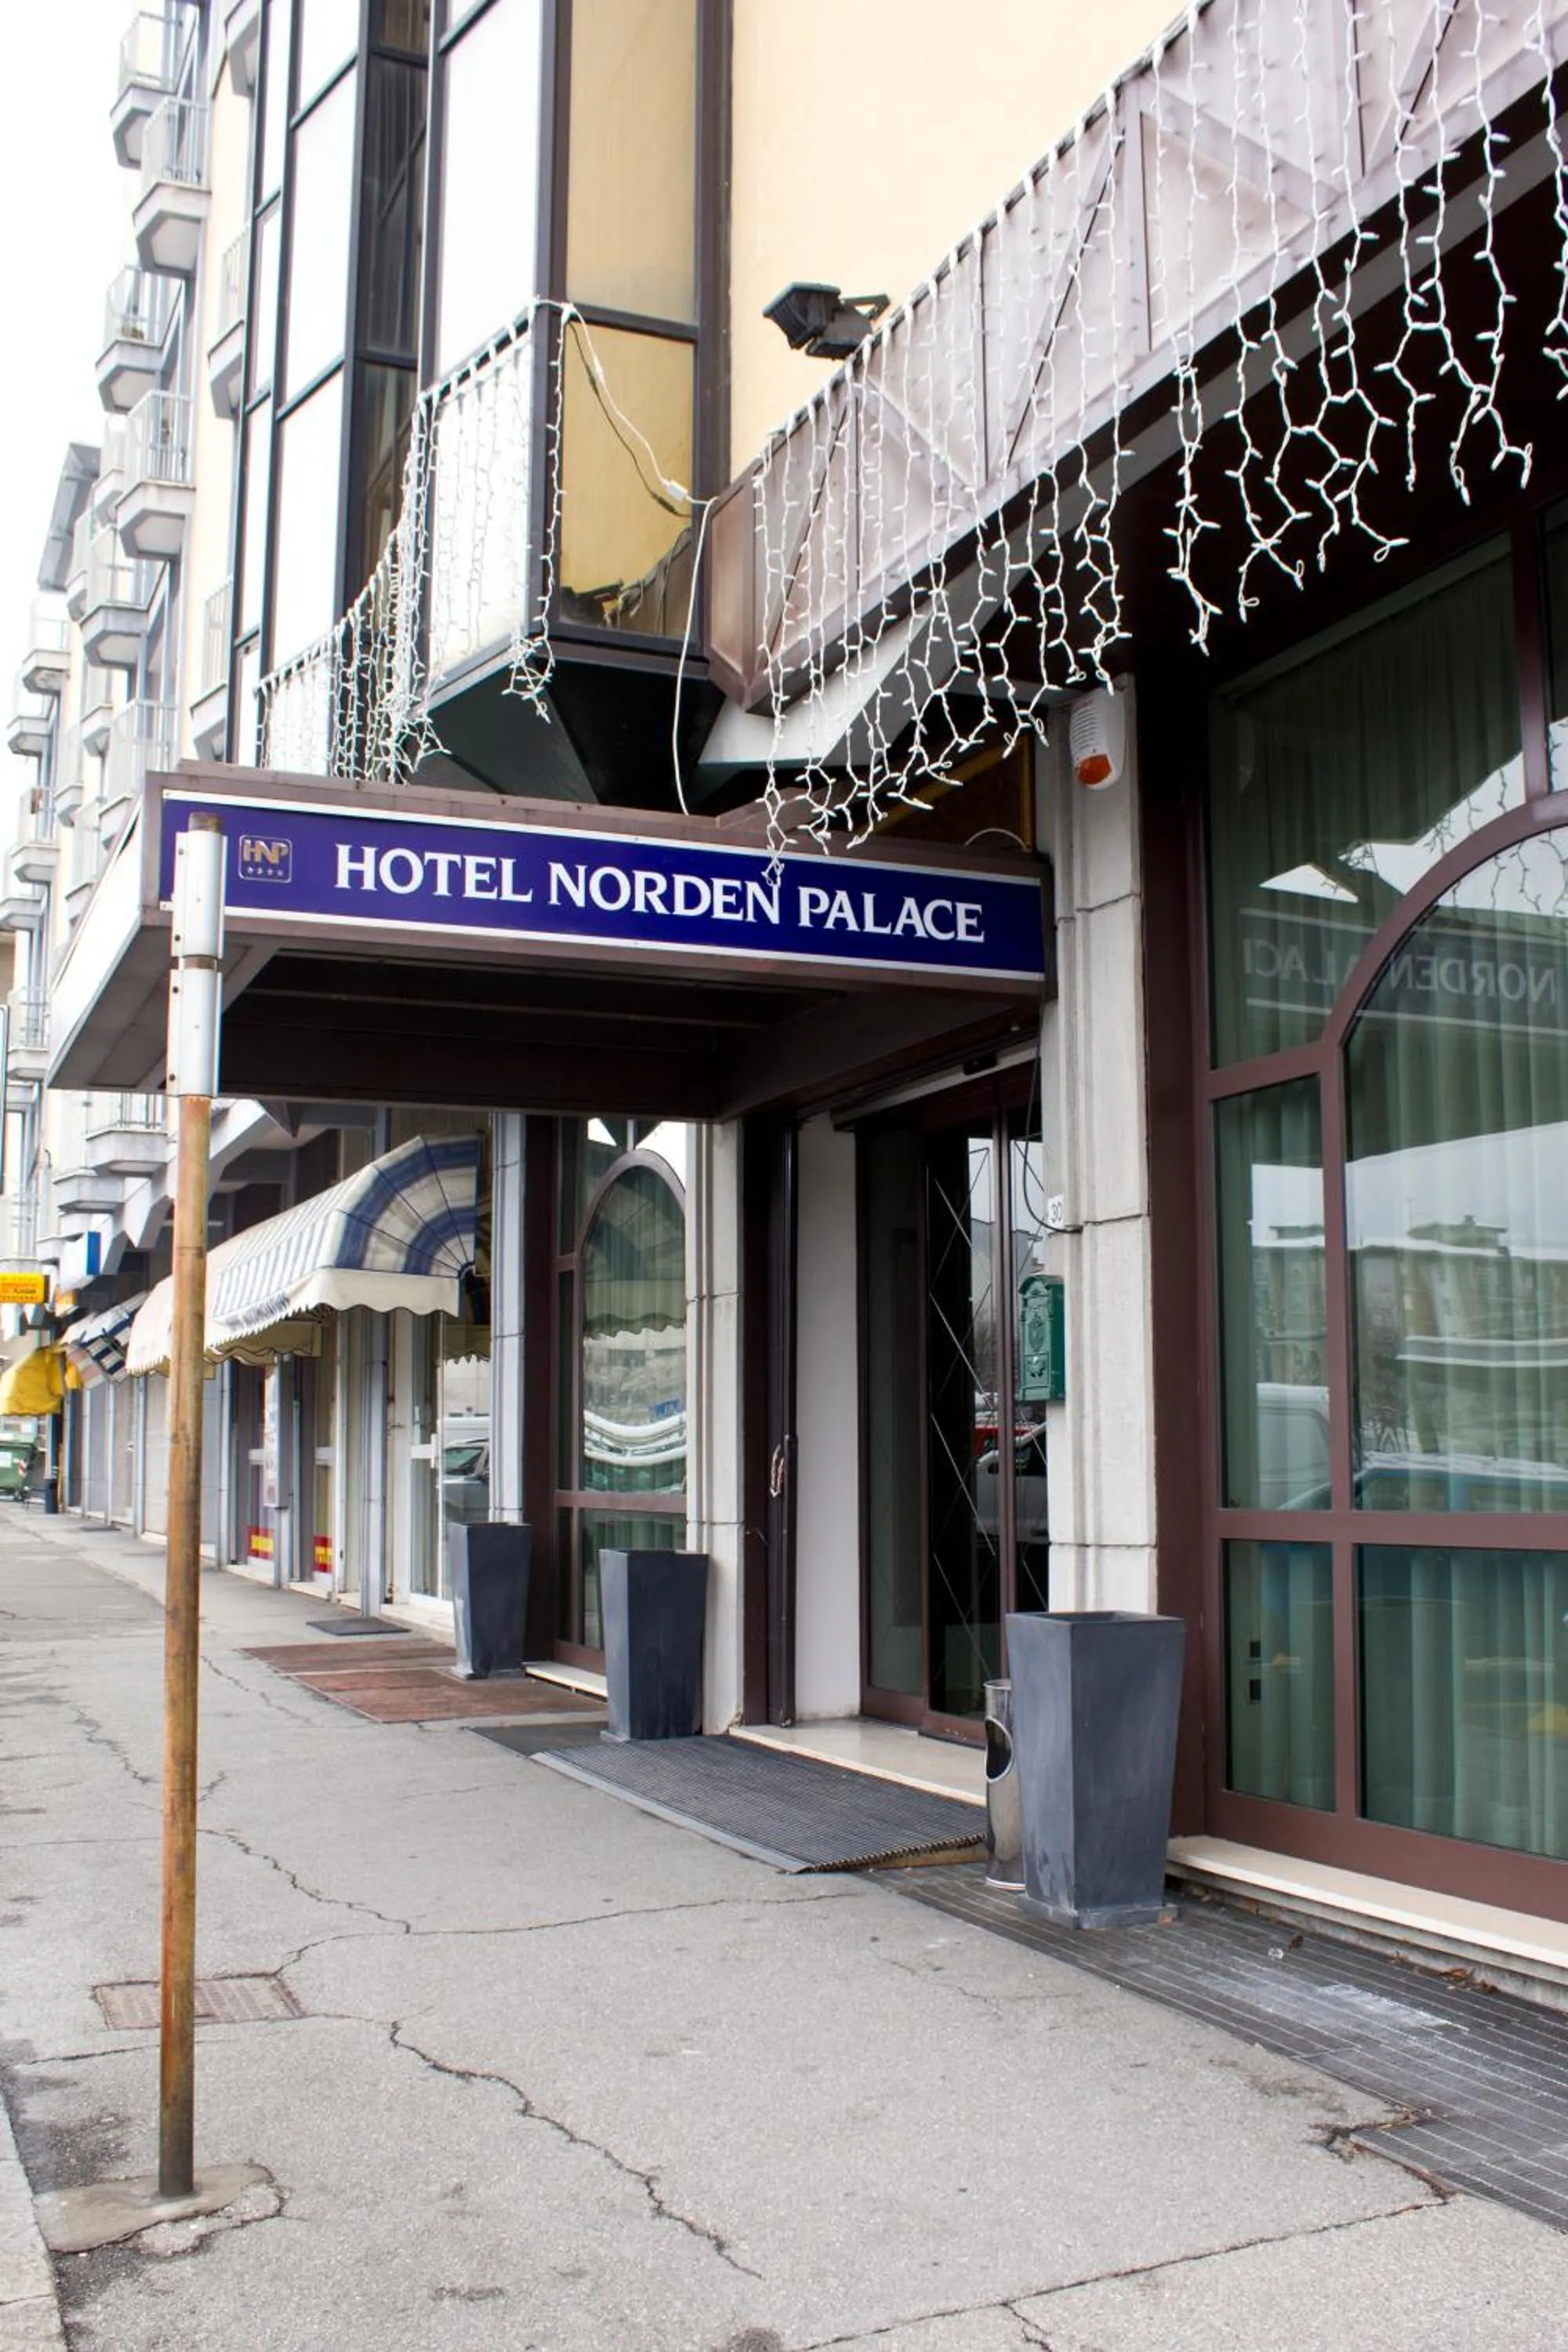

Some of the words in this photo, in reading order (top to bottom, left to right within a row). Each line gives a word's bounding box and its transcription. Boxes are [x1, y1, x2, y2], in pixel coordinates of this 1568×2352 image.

[335, 844, 532, 902] HOTEL
[549, 862, 780, 925] NORDEN
[797, 886, 985, 943] PALACE
